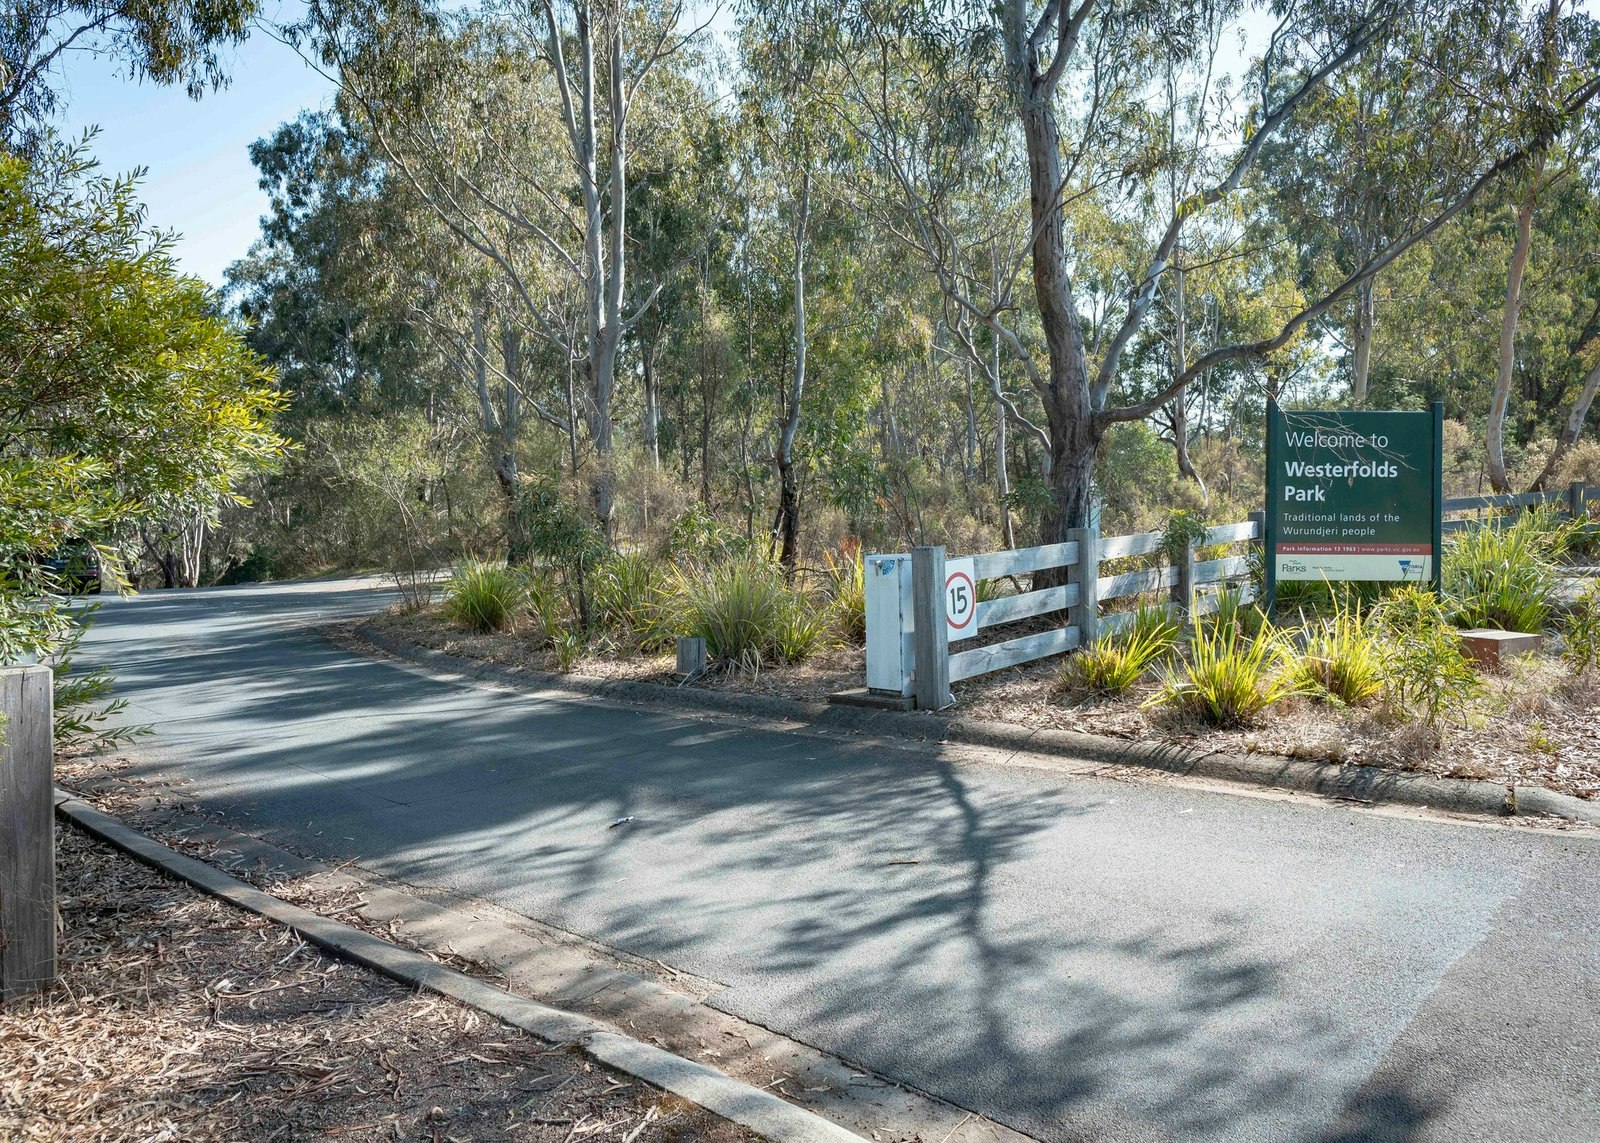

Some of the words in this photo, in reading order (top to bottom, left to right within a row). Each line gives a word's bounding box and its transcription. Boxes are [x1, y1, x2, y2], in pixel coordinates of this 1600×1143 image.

[1286, 432, 1365, 448] Welcome
[1373, 433, 1388, 448] to
[1285, 461, 1398, 477] Westerfolds
[1285, 485, 1325, 501] Park
[1284, 513, 1335, 522] Traditional
[1340, 513, 1366, 522] lands
[1370, 513, 1379, 522] of
[1384, 513, 1399, 522] the
[1283, 527, 1338, 536] Wurundjeri
[1342, 527, 1375, 536] people
[1283, 545, 1295, 553] Park
[1296, 545, 1332, 553] Information
[1333, 545, 1341, 553] 13
[1343, 545, 1356, 553] 1963
[1282, 564, 1306, 572] Parks
[950, 586, 967, 615] 15
